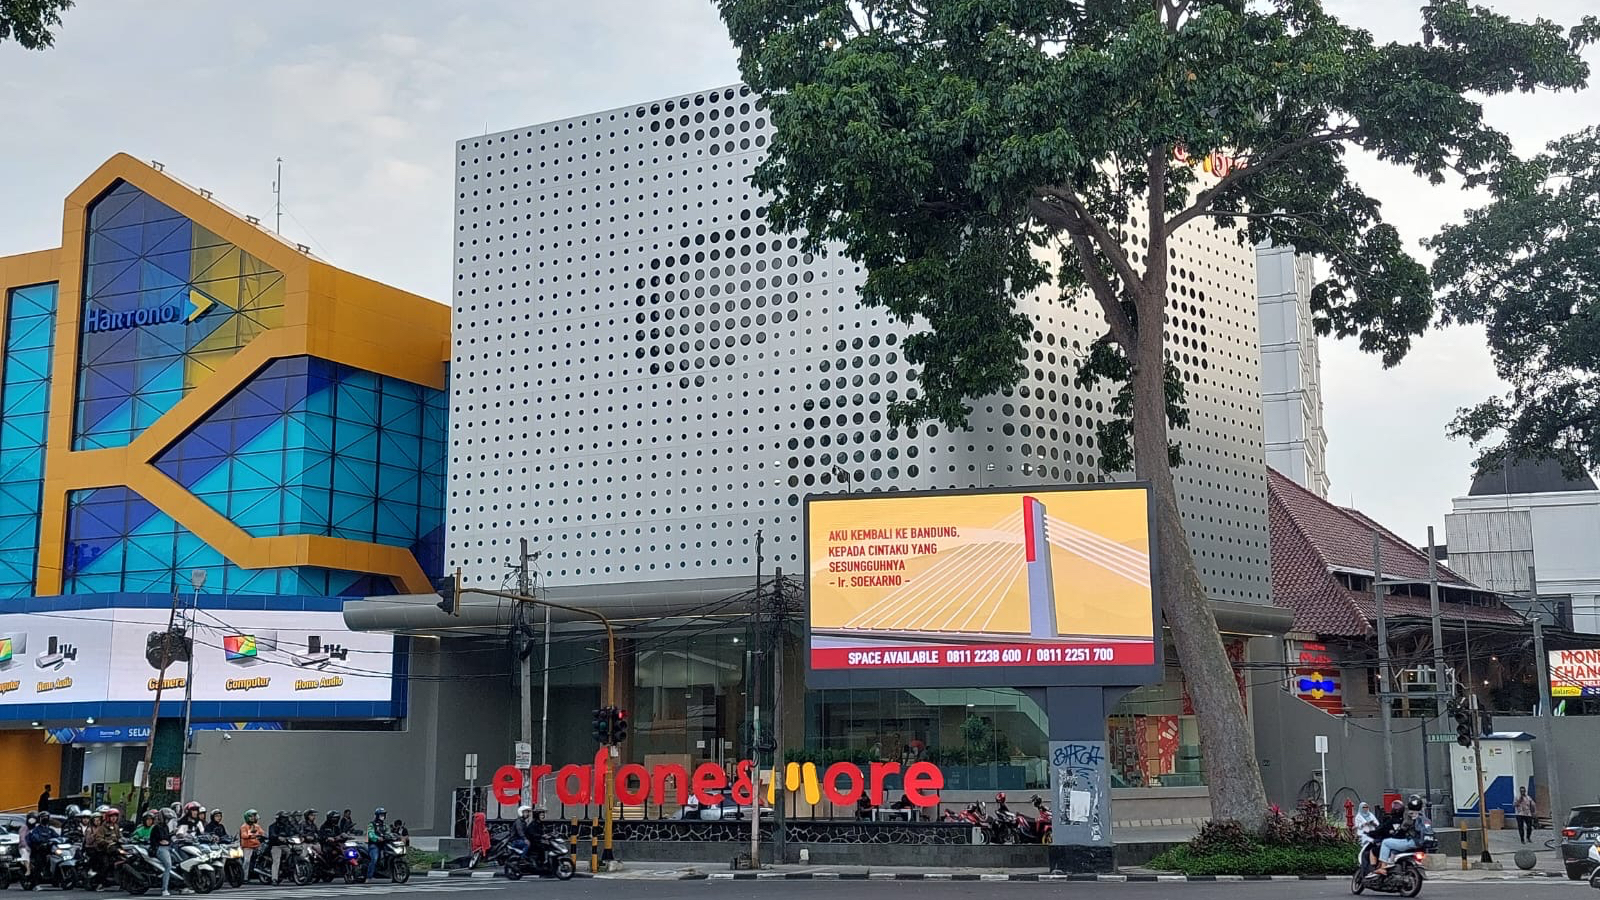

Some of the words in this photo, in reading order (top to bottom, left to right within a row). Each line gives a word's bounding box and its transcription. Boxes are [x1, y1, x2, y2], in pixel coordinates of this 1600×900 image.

[829, 530, 848, 541] AKU
[850, 529, 892, 540] KEMBALI
[895, 528, 908, 539] KE
[828, 546, 866, 557] KEPADA
[868, 544, 908, 556] CINTAKU
[911, 543, 937, 555] YANG
[828, 560, 906, 573] SESUNGGUHNYA
[837, 577, 849, 588] Ir.
[850, 575, 902, 587] SOEKARNO
[848, 651, 882, 665] SPACE
[883, 650, 939, 664] AVAILABLE
[946, 650, 971, 663] 0811
[974, 649, 1000, 663] 2238
[1001, 649, 1022, 662] 600
[1036, 648, 1062, 662] 0811
[1064, 648, 1090, 662] 2251
[1093, 648, 1114, 661] 700
[1554, 665, 1600, 680] CHAN
[226, 677, 271, 691] Computer
[295, 679, 319, 691] Home
[320, 675, 344, 689] Audio
